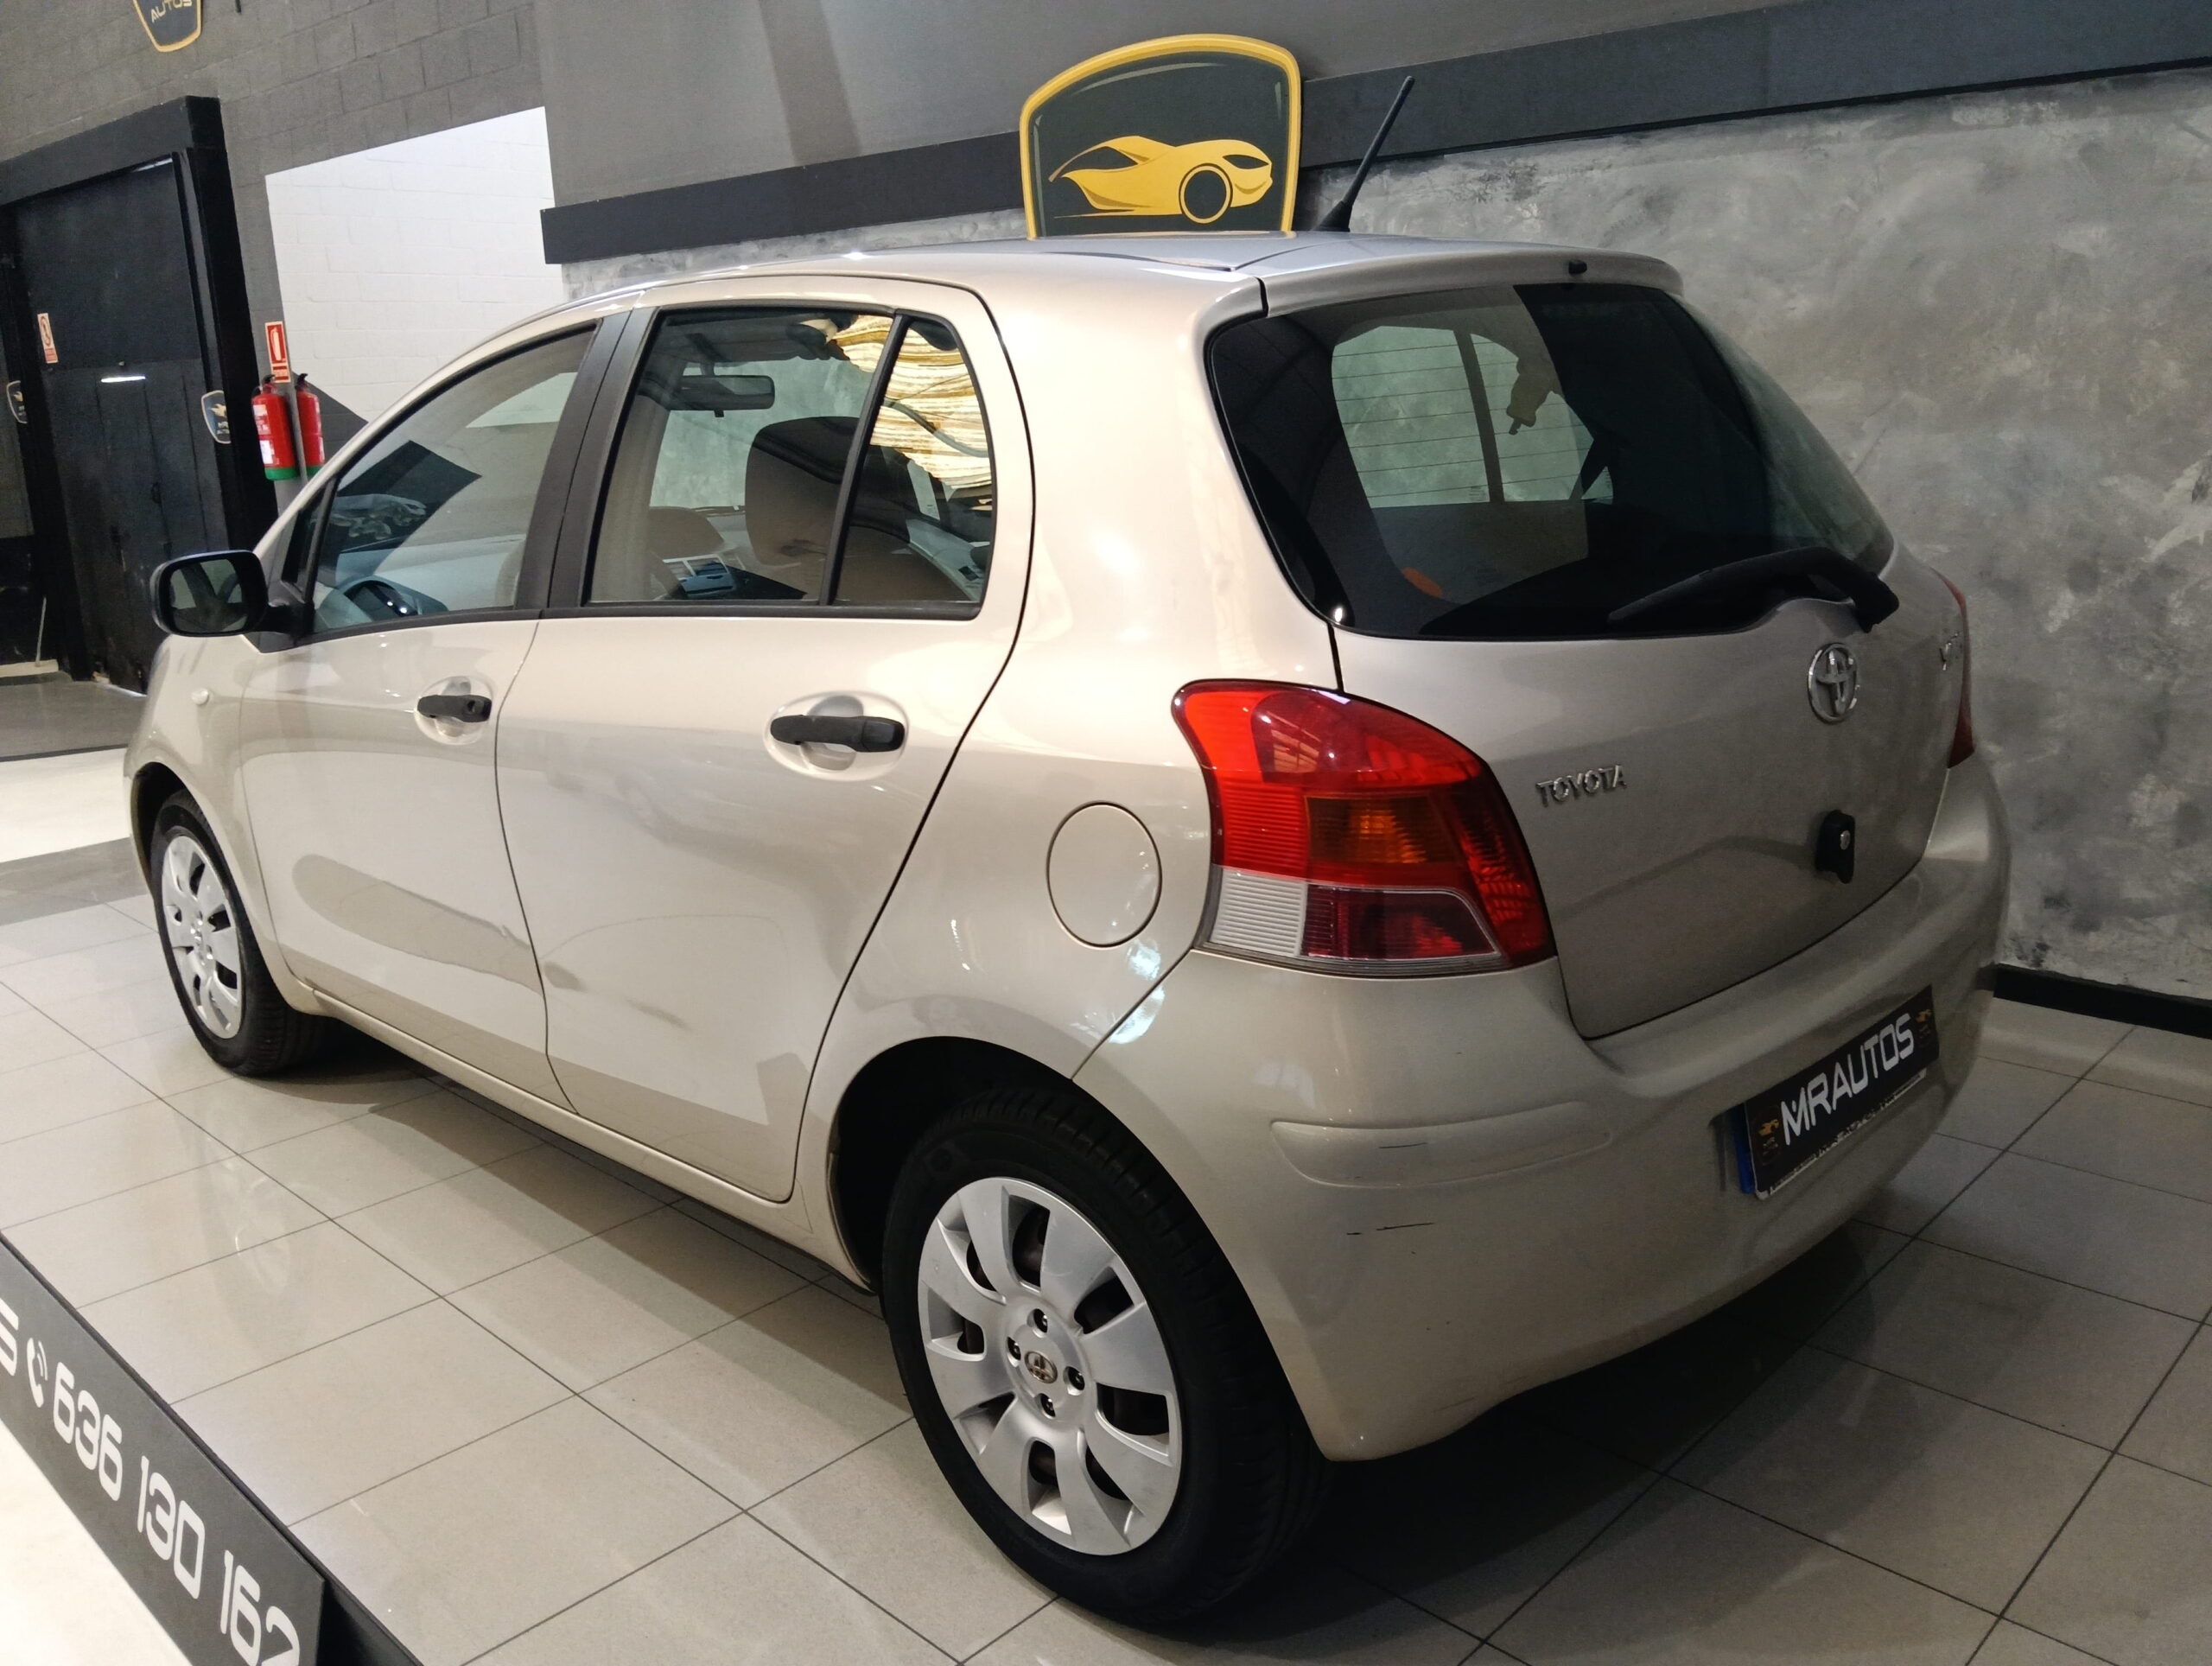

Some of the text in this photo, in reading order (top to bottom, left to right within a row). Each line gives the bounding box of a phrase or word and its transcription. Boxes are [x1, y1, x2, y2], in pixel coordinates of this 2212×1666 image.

[1535, 764, 1628, 807] TOYOTA
[1780, 1012, 1915, 1147] MRAUTOS
[53, 1361, 123, 1502] 636
[137, 1454, 206, 1600] 130
[219, 1549, 301, 1666] 162
